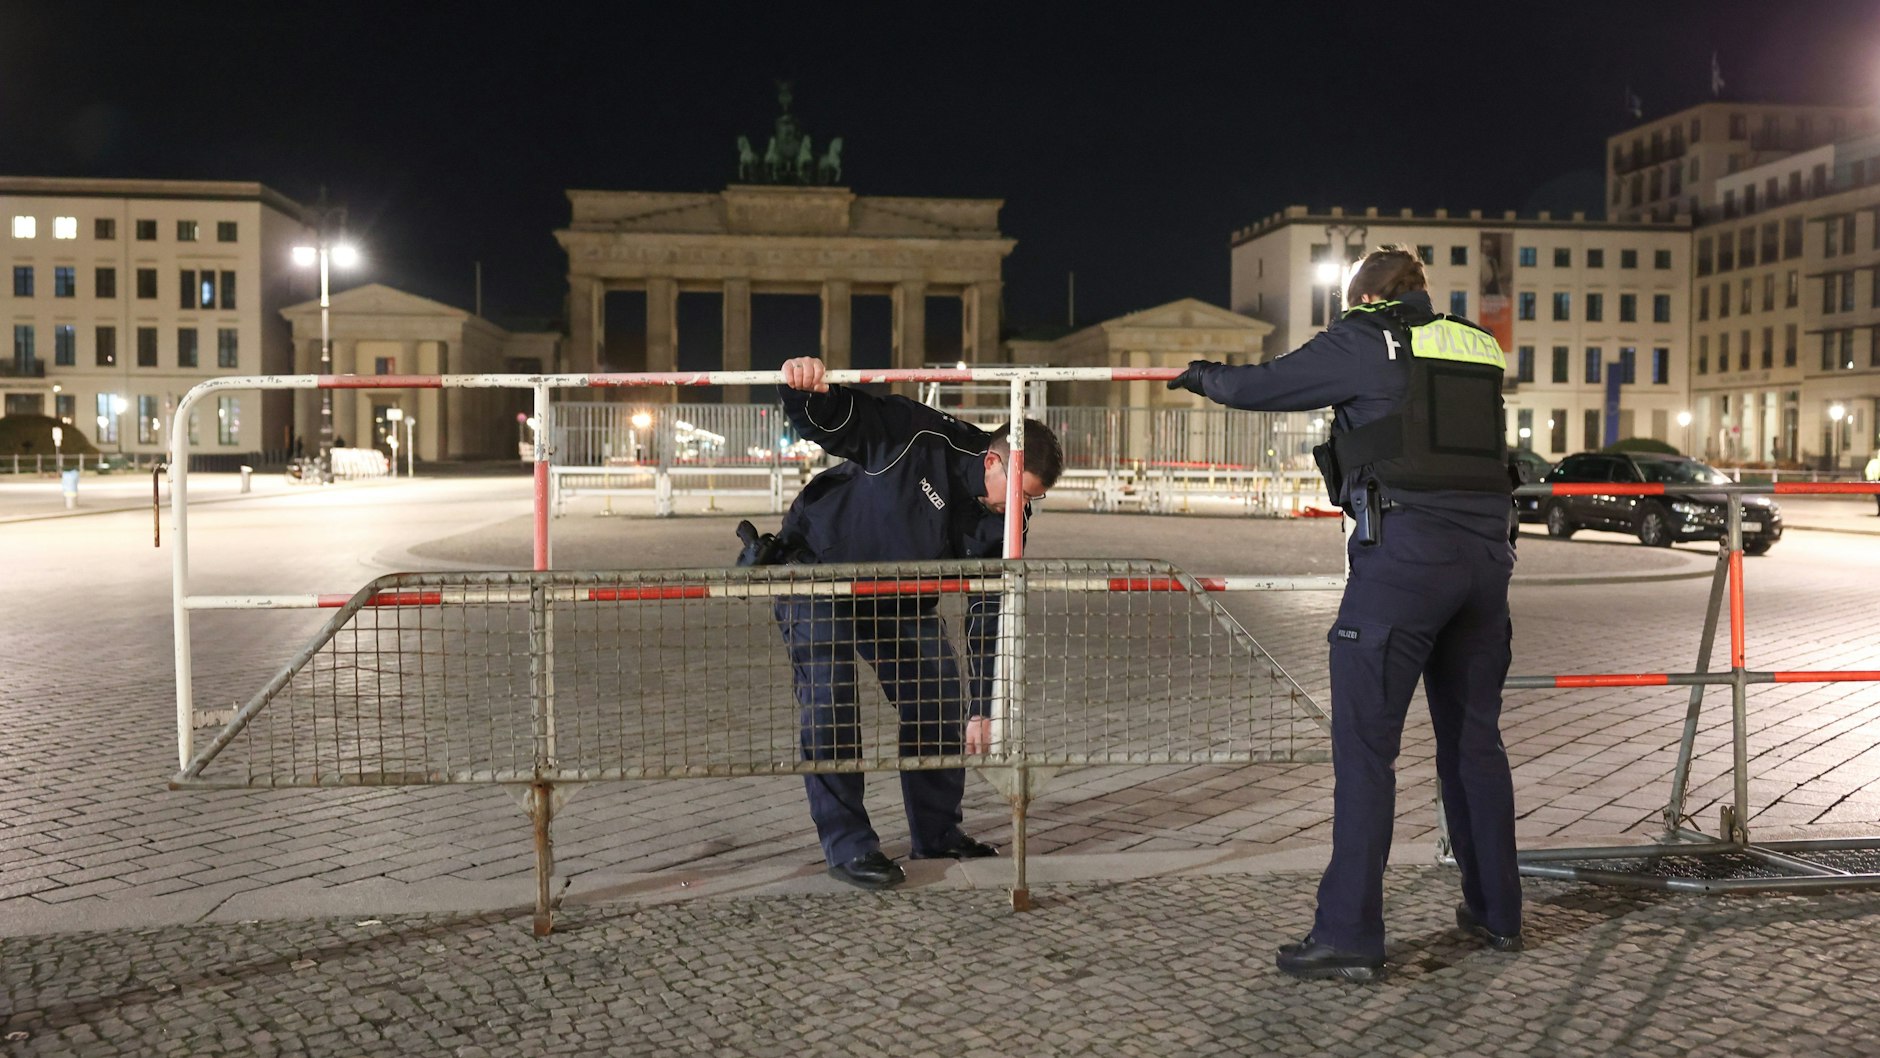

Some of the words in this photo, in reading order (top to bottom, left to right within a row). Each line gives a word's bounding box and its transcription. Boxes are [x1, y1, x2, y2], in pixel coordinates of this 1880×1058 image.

[1418, 323, 1502, 361] POLIZEI
[919, 477, 945, 510] POLIZEI
[1338, 629, 1358, 639] POLIZEI
